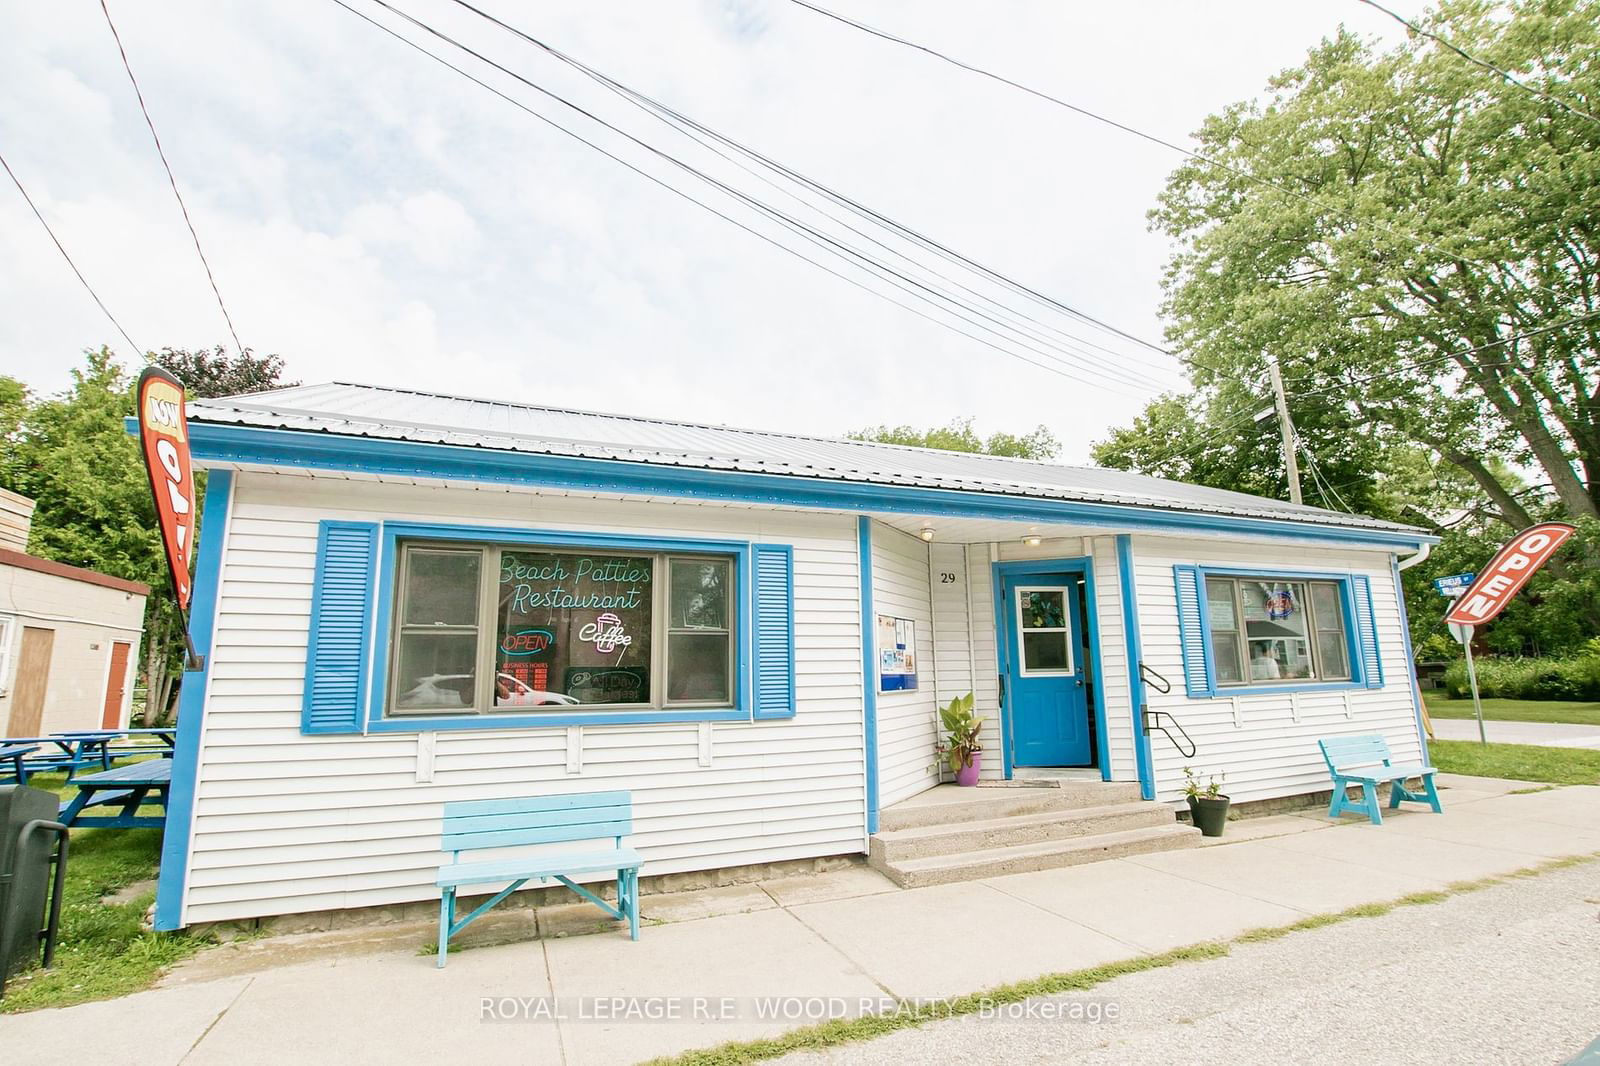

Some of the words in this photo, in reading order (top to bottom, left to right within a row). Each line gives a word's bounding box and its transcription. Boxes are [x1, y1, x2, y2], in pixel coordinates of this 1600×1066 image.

[499, 556, 570, 583] Beach
[574, 558, 650, 585] Patties
[940, 572, 956, 584] 29
[1461, 534, 1551, 619] OPEN
[512, 583, 641, 614] Restaurant
[502, 634, 548, 651] OPEN
[579, 622, 632, 649] Coffee
